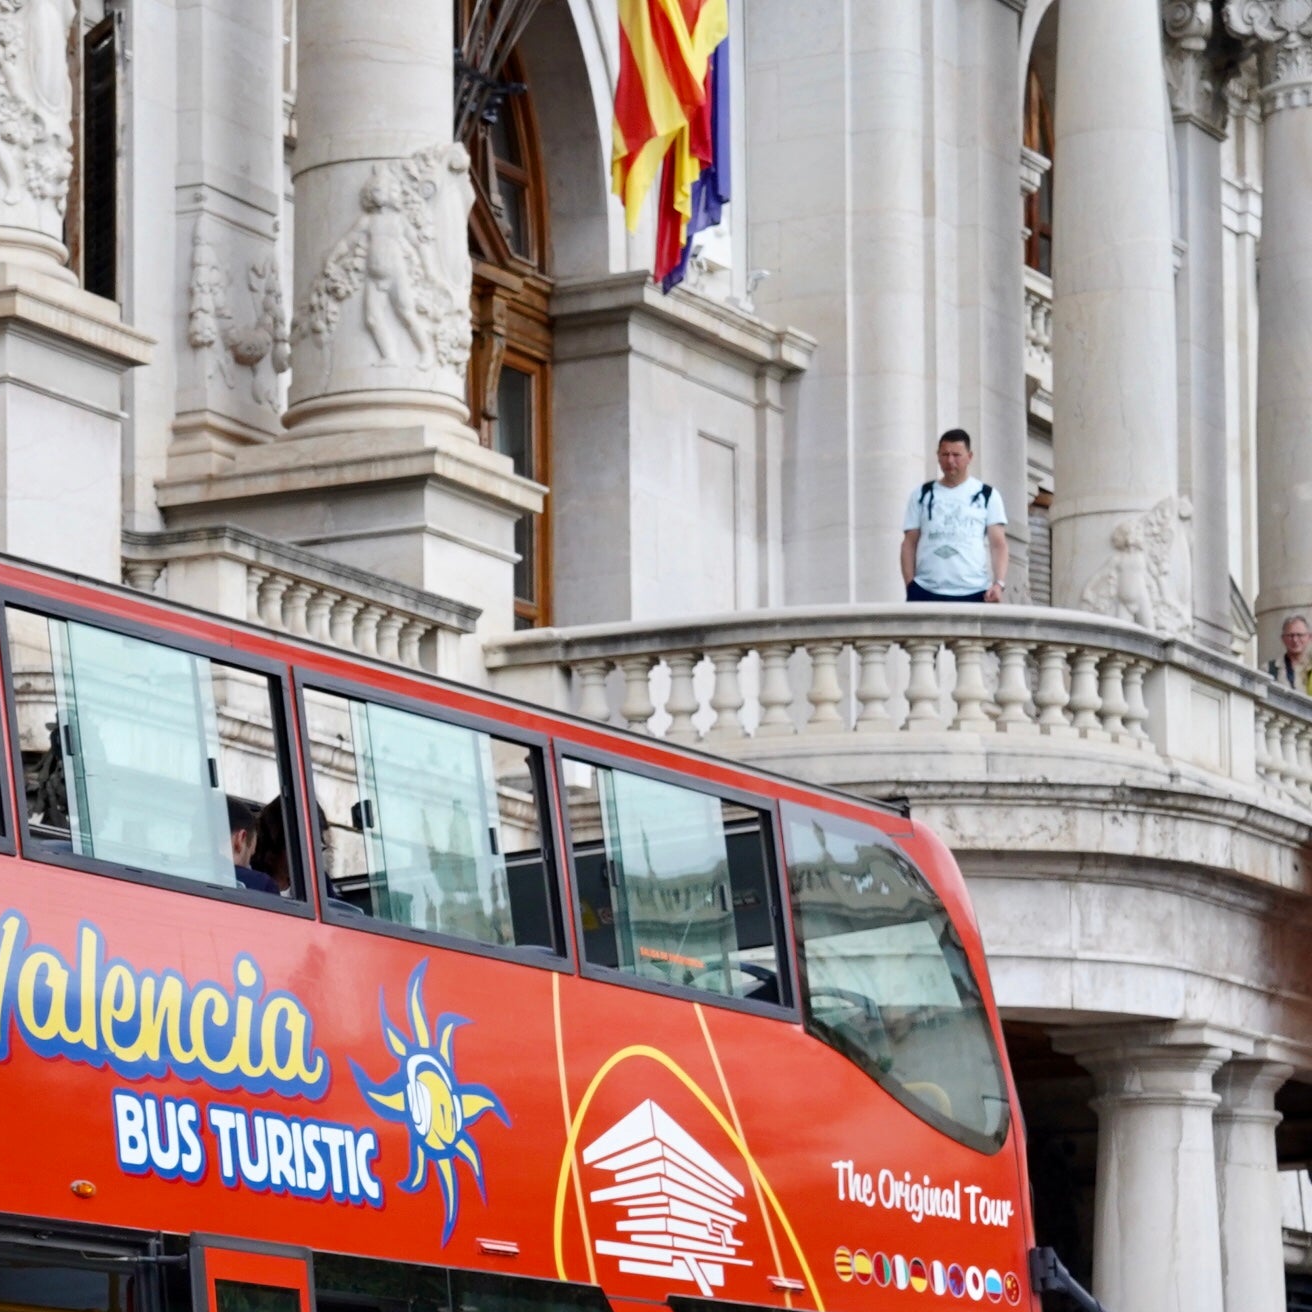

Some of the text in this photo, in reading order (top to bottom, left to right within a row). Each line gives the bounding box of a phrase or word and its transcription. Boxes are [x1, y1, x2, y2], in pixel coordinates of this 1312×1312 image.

[114, 1094, 381, 1200] BUS TURISTIC
[831, 1159, 1015, 1228] The Original Tour
